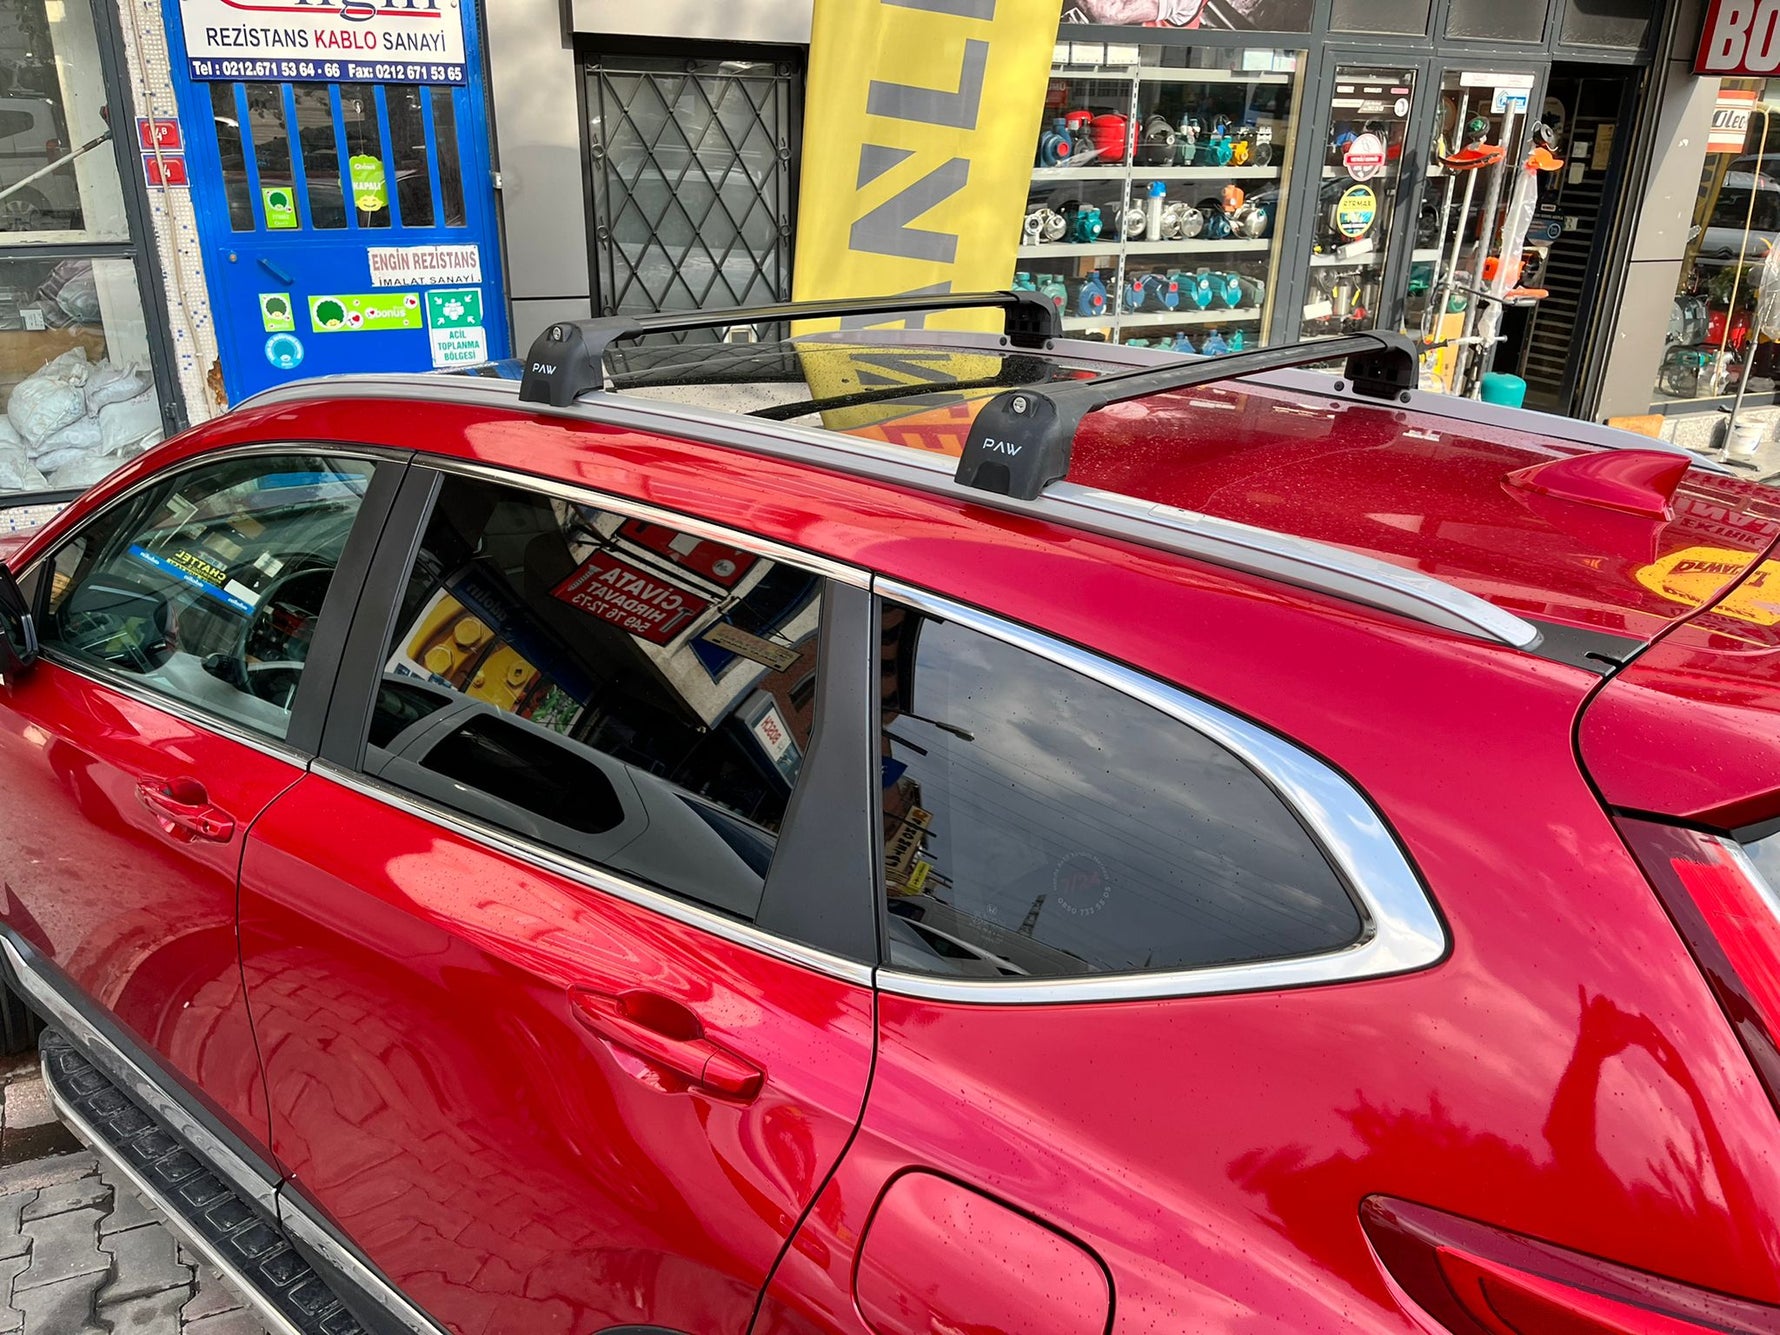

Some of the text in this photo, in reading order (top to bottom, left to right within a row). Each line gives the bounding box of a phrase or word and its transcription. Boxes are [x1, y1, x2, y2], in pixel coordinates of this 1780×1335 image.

[205, 23, 447, 52] REZİSTANS KABLO SANAYİ
[192, 61, 213, 76] Tel
[222, 61, 278, 77] 0212.671
[281, 62, 297, 77] 53
[299, 63, 316, 78] 64
[324, 63, 341, 78] 66
[348, 64, 374, 80] Fax:
[375, 64, 406, 80] 0212
[407, 65, 428, 80] 671
[430, 65, 446, 80] 53
[447, 66, 463, 81] 65
[371, 246, 478, 272] ENGİN REZİSTANS
[379, 273, 475, 287] İMALAT SANAYİ
[449, 330, 467, 340] ACİL
[437, 340, 481, 352] TOPLANMA
[443, 350, 477, 362] BÖLGESİ
[532, 362, 557, 375] PAW
[982, 437, 1023, 456] PAW
